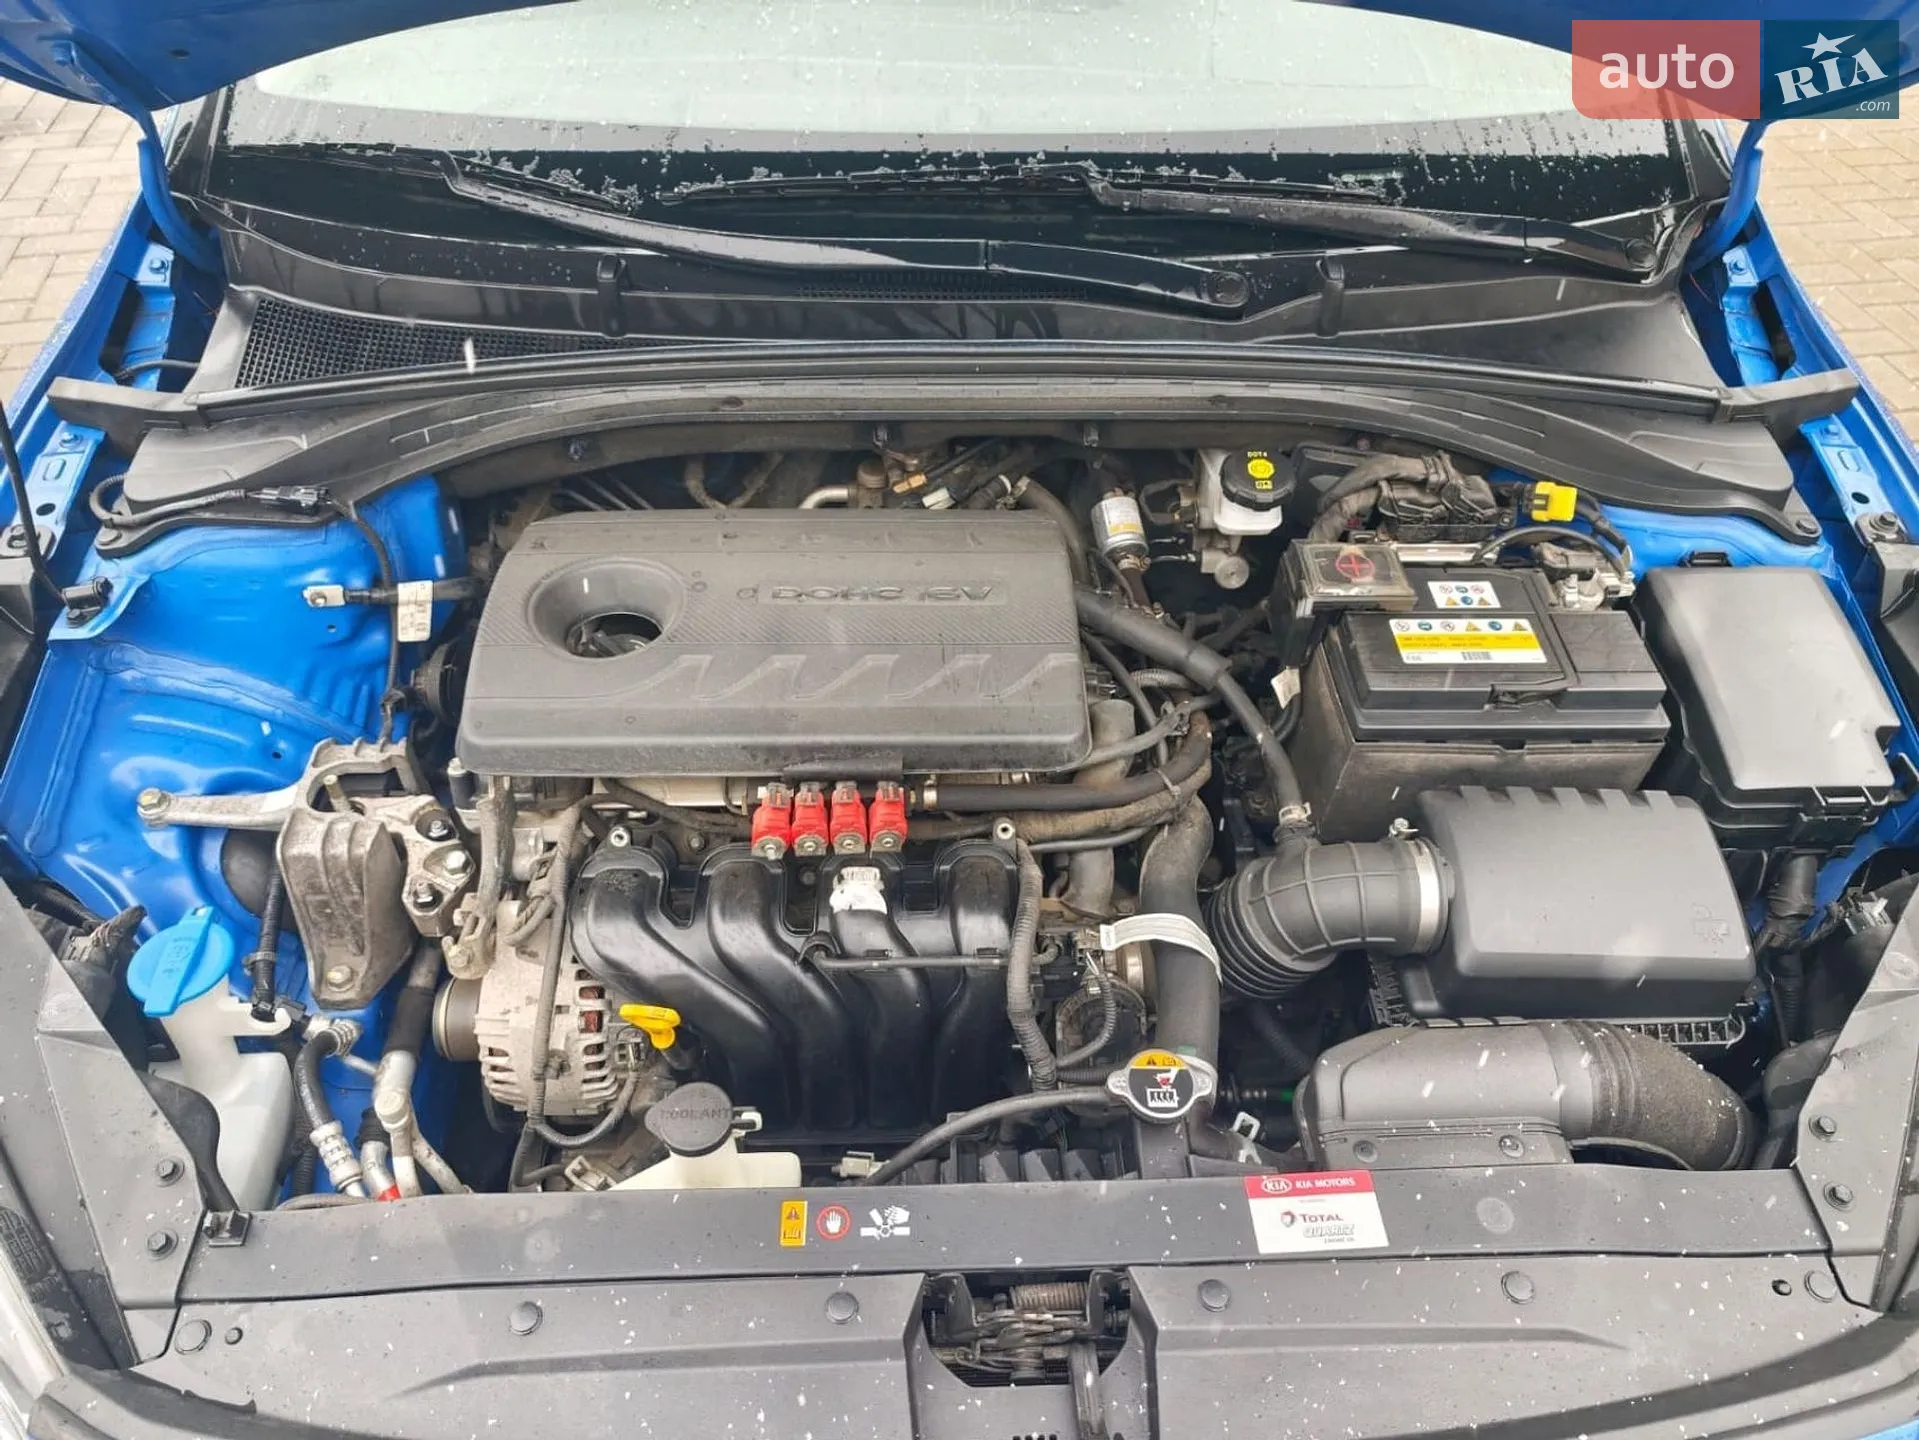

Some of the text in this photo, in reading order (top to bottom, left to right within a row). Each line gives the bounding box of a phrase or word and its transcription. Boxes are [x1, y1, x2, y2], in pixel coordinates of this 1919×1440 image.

[771, 585, 904, 602] DOHC
[1295, 1179, 1312, 1189] KIA
[1315, 1177, 1356, 1188] MOTORS
[1299, 1213, 1344, 1224] TOTAL
